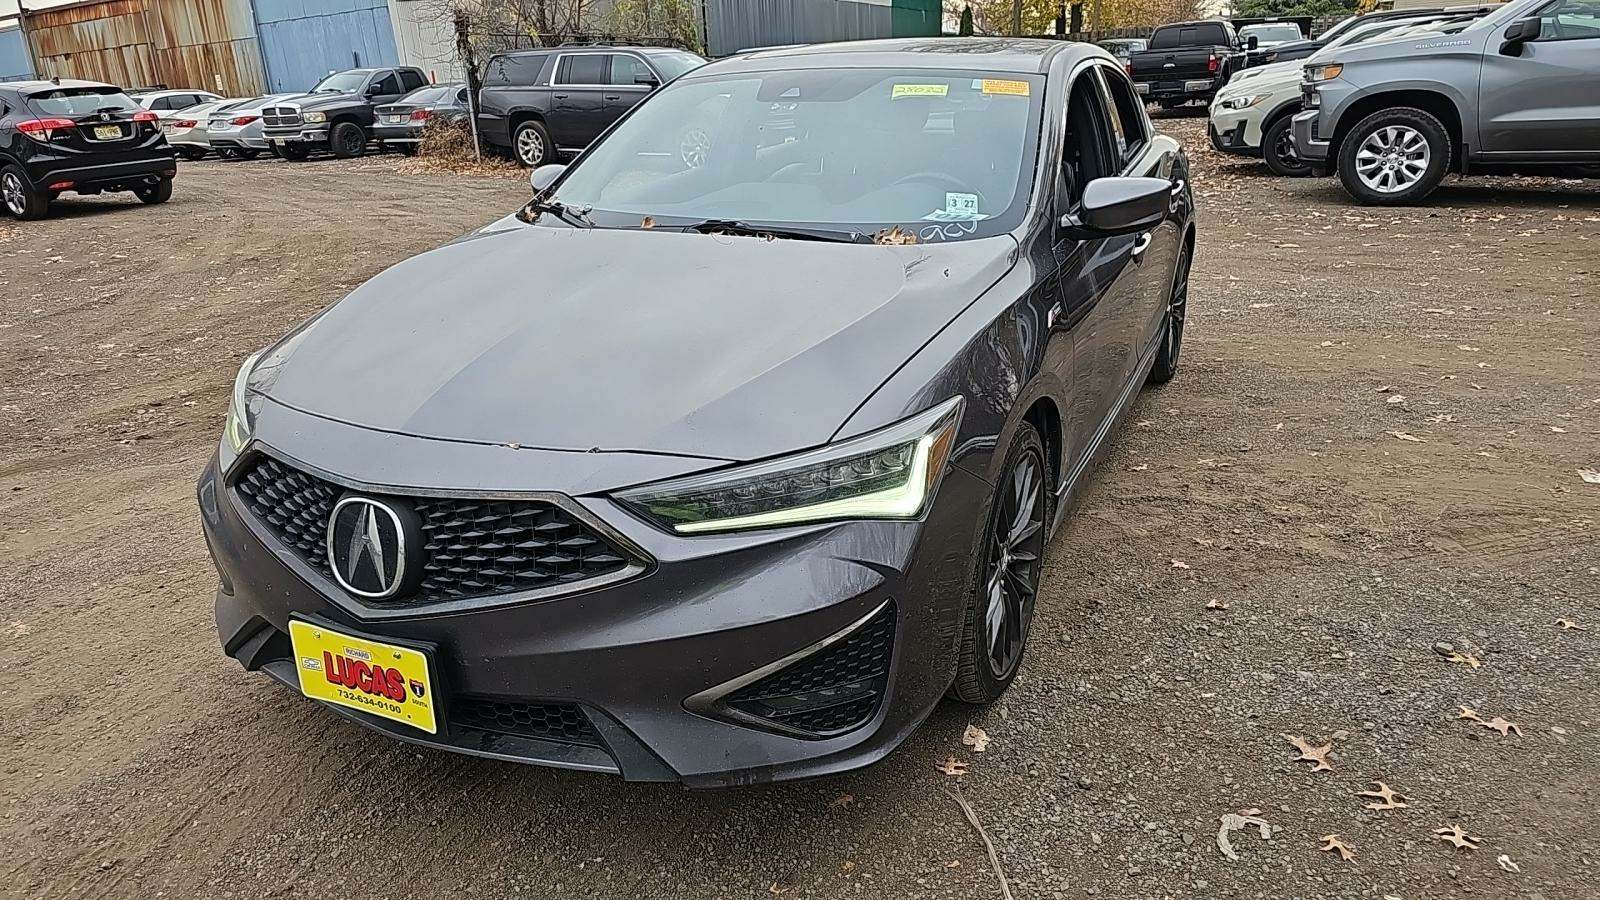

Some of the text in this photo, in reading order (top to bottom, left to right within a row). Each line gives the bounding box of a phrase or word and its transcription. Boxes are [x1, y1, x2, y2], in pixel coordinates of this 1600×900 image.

[1415, 39, 1471, 49] SILVERADO
[951, 198, 975, 208] 3 27
[323, 650, 407, 704] LUCAS
[336, 689, 402, 714] 732-634-0100
